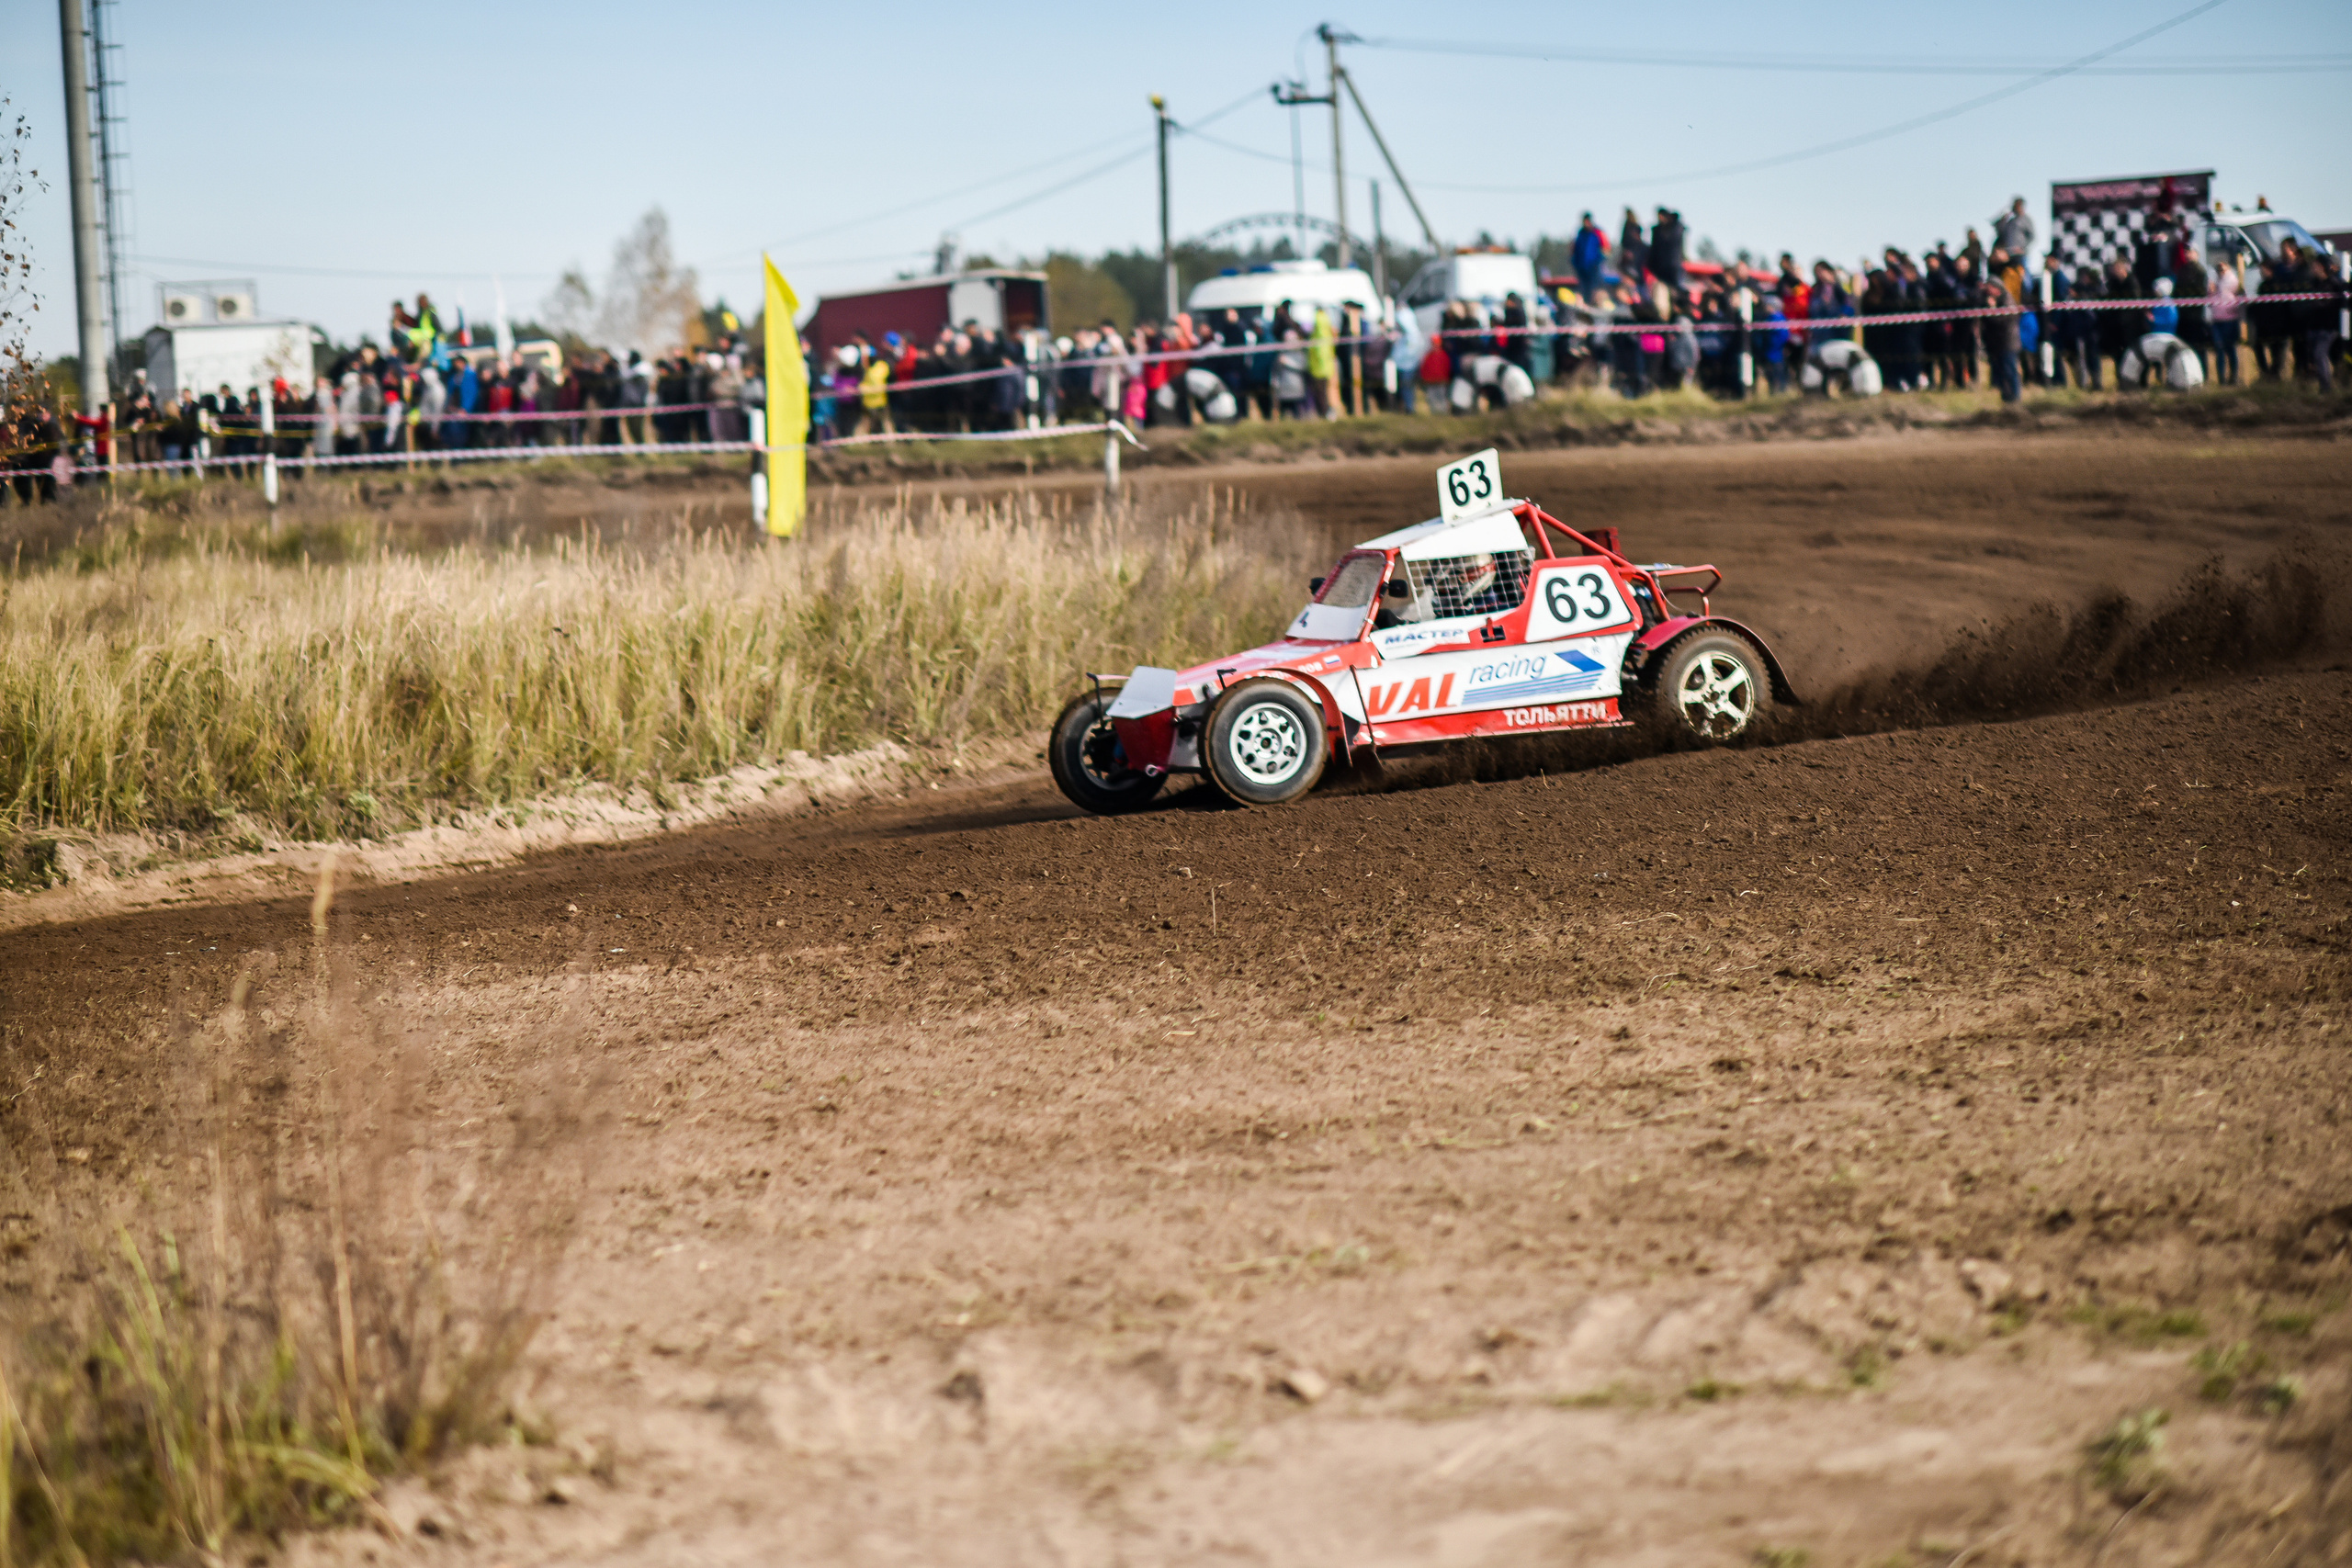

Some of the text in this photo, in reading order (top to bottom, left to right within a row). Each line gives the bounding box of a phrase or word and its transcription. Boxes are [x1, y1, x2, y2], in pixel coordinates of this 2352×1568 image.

[1448, 460, 1491, 507] 63
[1545, 573, 1611, 624] 63
[1385, 628, 1464, 645] МАСТЕР
[1368, 654, 1547, 716] VAL racing
[1502, 701, 1607, 727] ТОЛЬЯТТИ
